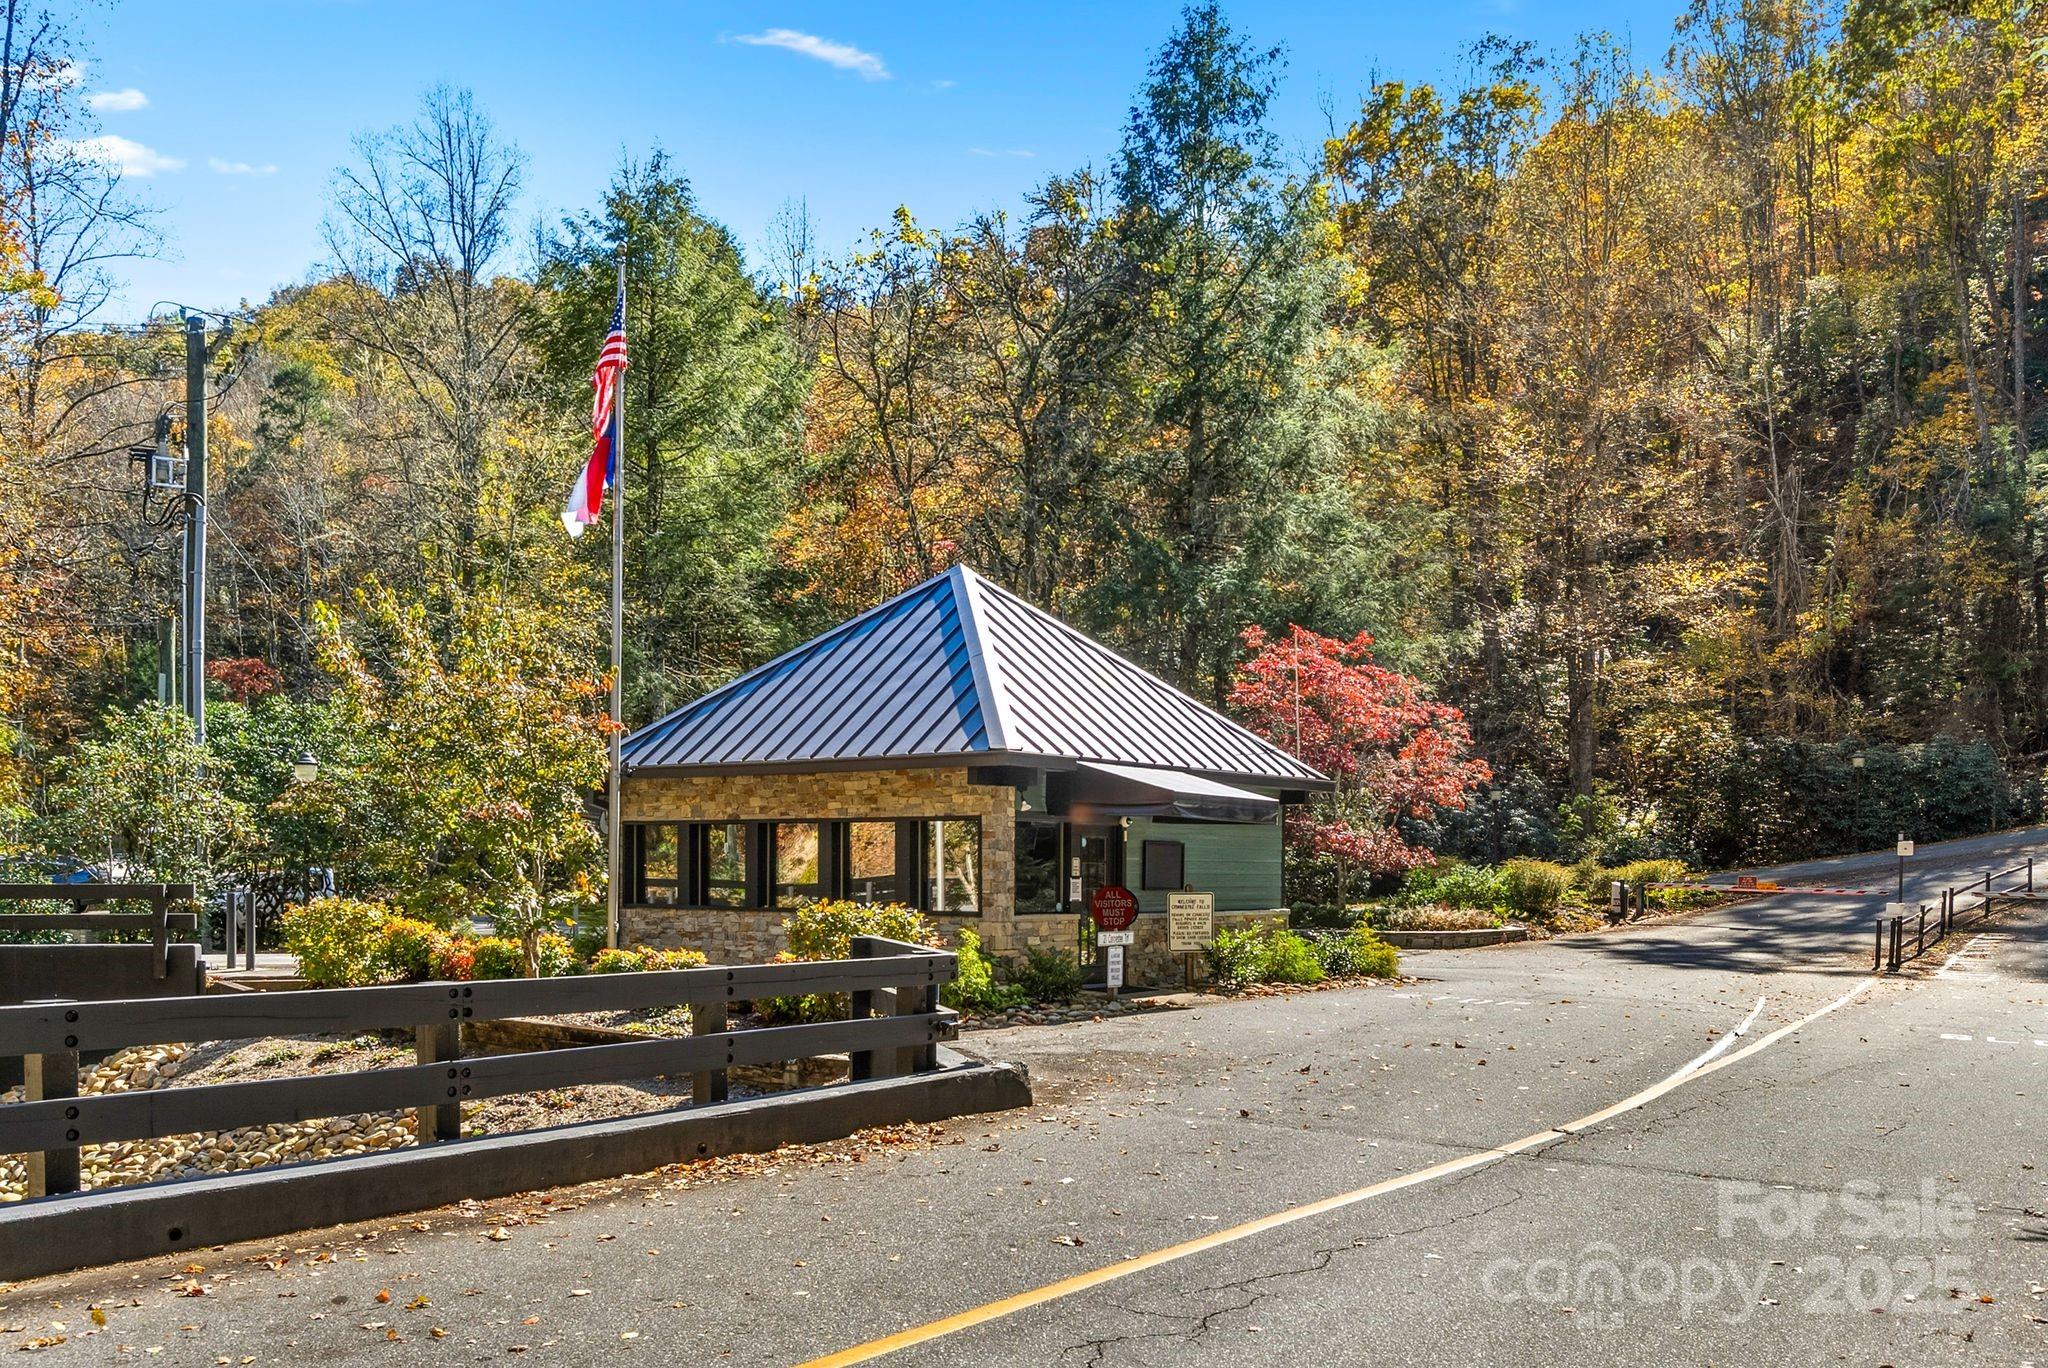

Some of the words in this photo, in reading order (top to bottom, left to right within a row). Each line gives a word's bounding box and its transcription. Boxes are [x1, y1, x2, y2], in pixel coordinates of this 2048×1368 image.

[1105, 890, 1121, 899] ALL
[1095, 900, 1132, 908] VISITORS
[1103, 908, 1125, 917] MUST
[1104, 917, 1125, 926] STOP
